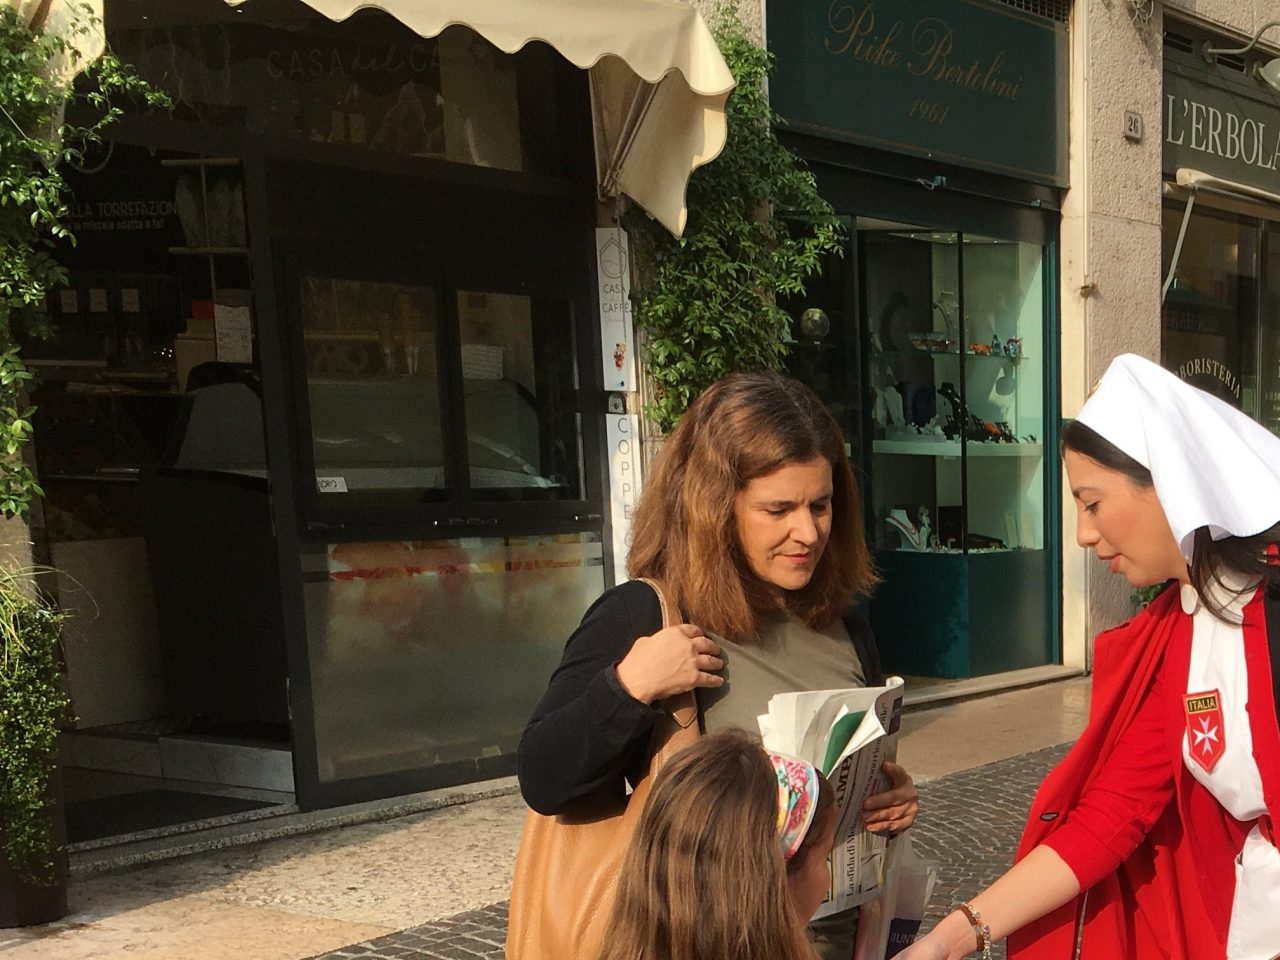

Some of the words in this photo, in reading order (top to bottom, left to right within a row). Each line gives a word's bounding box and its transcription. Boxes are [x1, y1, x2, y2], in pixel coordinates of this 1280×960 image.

[267, 48, 344, 79] CASA
[906, 16, 1023, 100] Bertolini
[908, 96, 952, 124] 1961
[1127, 115, 1139, 134] 26
[96, 200, 176, 217] TORREFAZION
[603, 283, 626, 294] CASA
[1189, 697, 1216, 712] ITALIA
[846, 844, 855, 856] di
[846, 856, 855, 882] sfida
